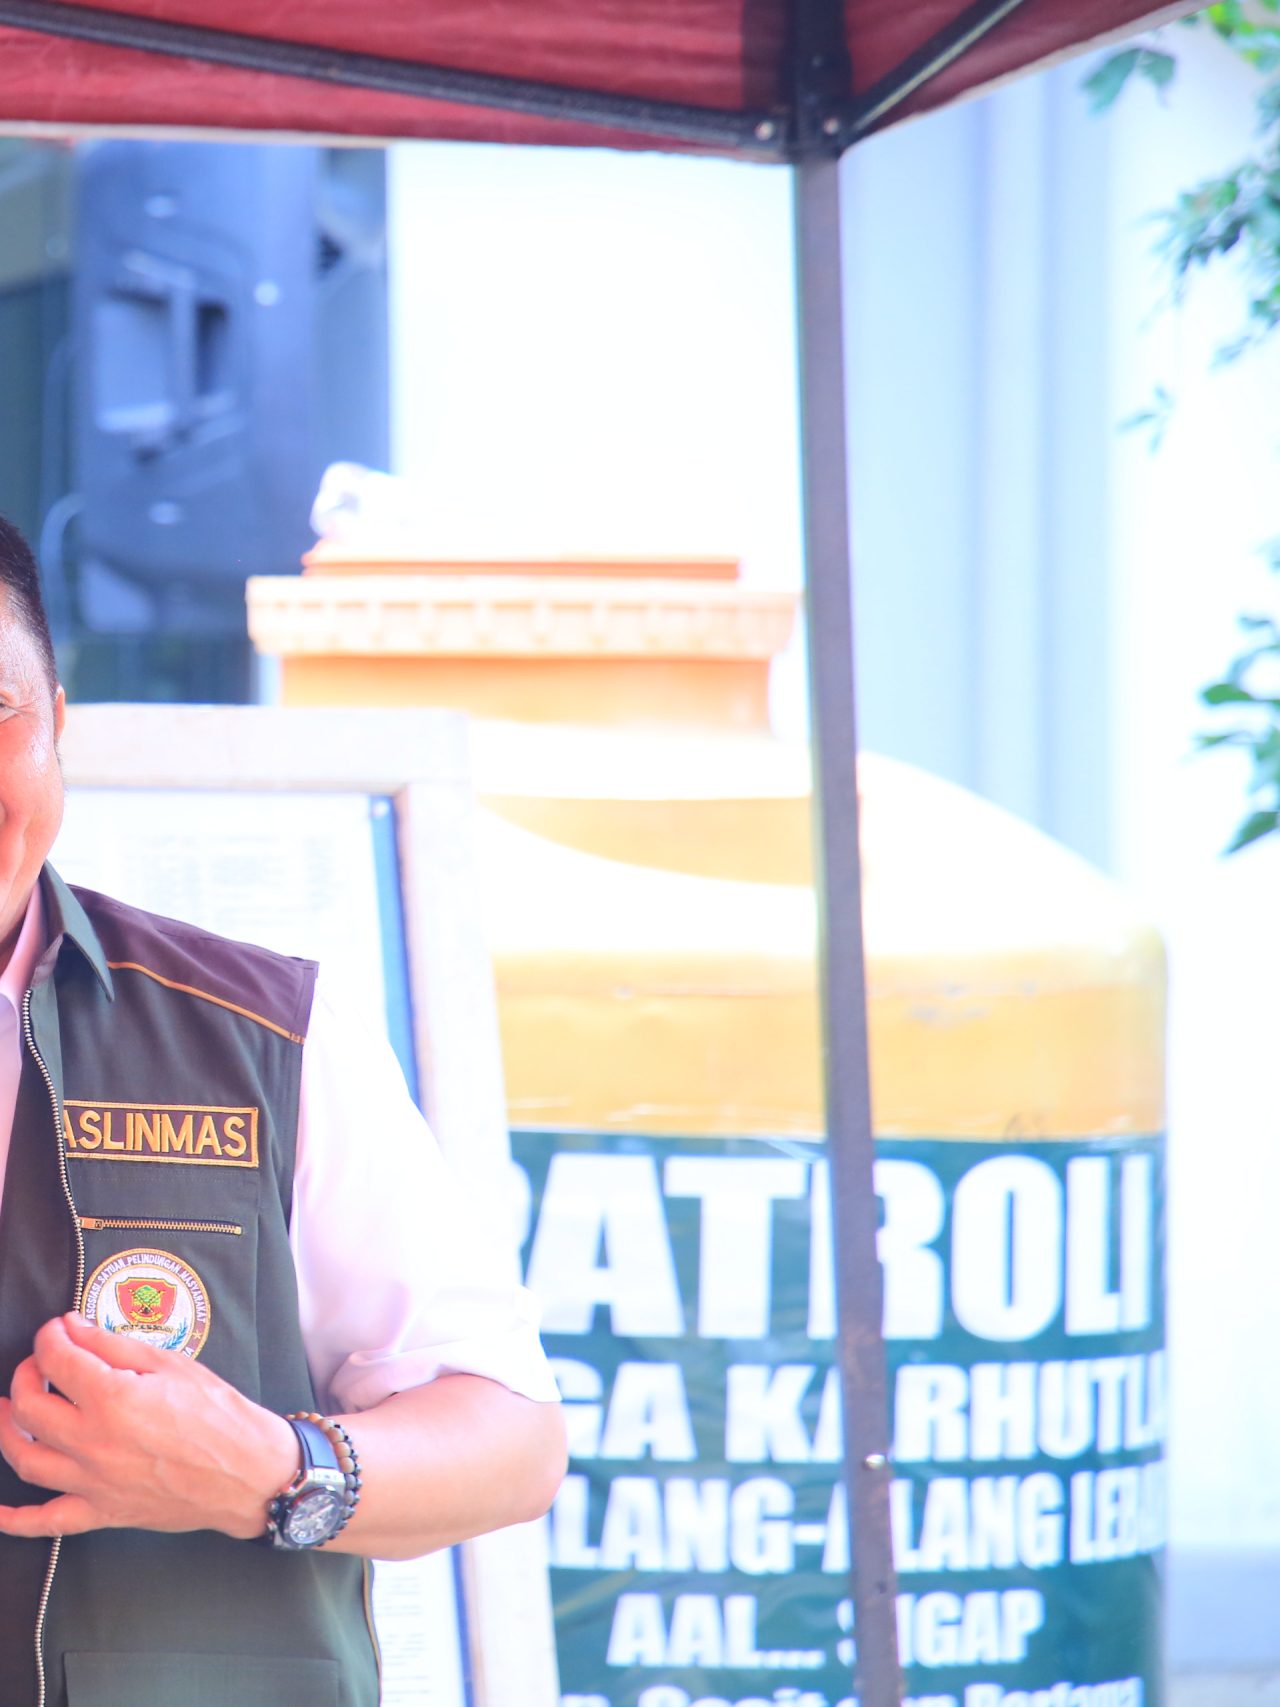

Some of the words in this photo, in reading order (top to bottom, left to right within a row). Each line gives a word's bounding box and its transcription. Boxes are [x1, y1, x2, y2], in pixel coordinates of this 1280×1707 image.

[86, 1284, 102, 1320] ASOSIASI
[98, 1258, 126, 1284] SATUAN
[126, 1253, 181, 1274] PELINDUNGAN
[181, 1270, 207, 1323] MASYARAKAT
[510, 1153, 1154, 1342] ATROLI
[548, 1471, 1066, 1575] LANG-LANG
